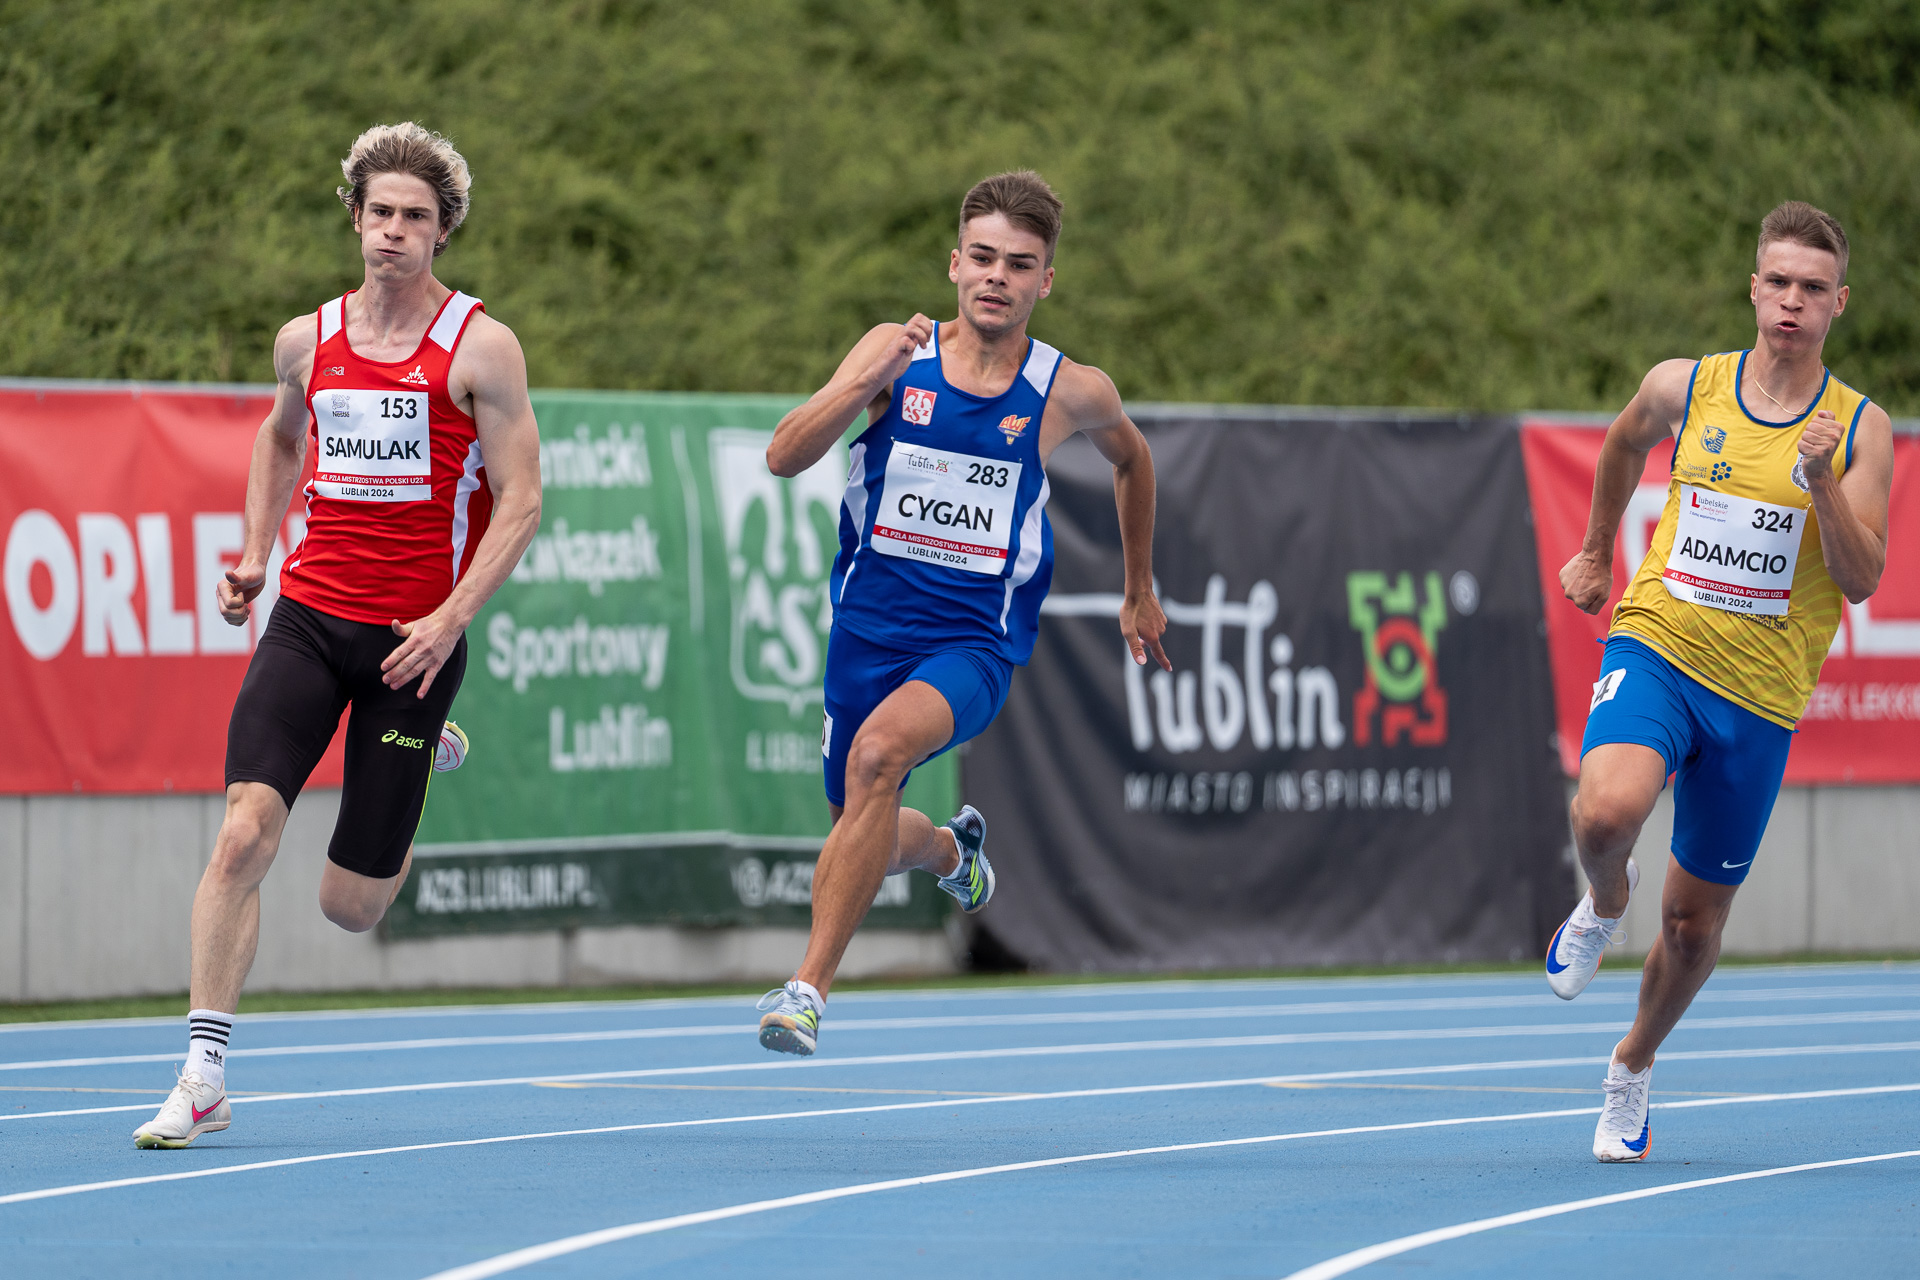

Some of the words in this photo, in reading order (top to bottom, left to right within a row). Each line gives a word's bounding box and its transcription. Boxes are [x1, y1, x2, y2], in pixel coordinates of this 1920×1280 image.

[380, 397, 418, 419] 153
[325, 436, 422, 460] SAMULAK
[341, 475, 385, 484] MISTRZOSTWA
[965, 463, 1009, 488] 283
[341, 487, 369, 497] LUBLIN
[370, 488, 394, 497] 2024
[898, 493, 993, 532] CYGAN
[1751, 508, 1793, 533] 324
[879, 528, 889, 536] 41.
[889, 531, 907, 541] PZLA
[907, 535, 960, 551] MISTRZOSTWA
[960, 544, 985, 554] POLSKI
[985, 548, 1000, 556] U23
[907, 545, 941, 560] LUBLIN
[942, 552, 968, 565] 2024
[1679, 536, 1787, 575] ADAMCIO
[1670, 572, 1679, 580] 41.
[1680, 574, 1695, 585] PZLA
[1695, 578, 1745, 595] MISTRZOSTWA
[1745, 589, 1770, 598] POLSKI
[1693, 590, 1726, 605] LUBLIN
[1727, 597, 1753, 609] 2024
[486, 610, 670, 694] Sportowy
[1594, 674, 1613, 704] 4
[549, 702, 673, 772] Lublin
[1123, 770, 1254, 813] MIASTO
[1263, 767, 1452, 814] INSPIRACJI
